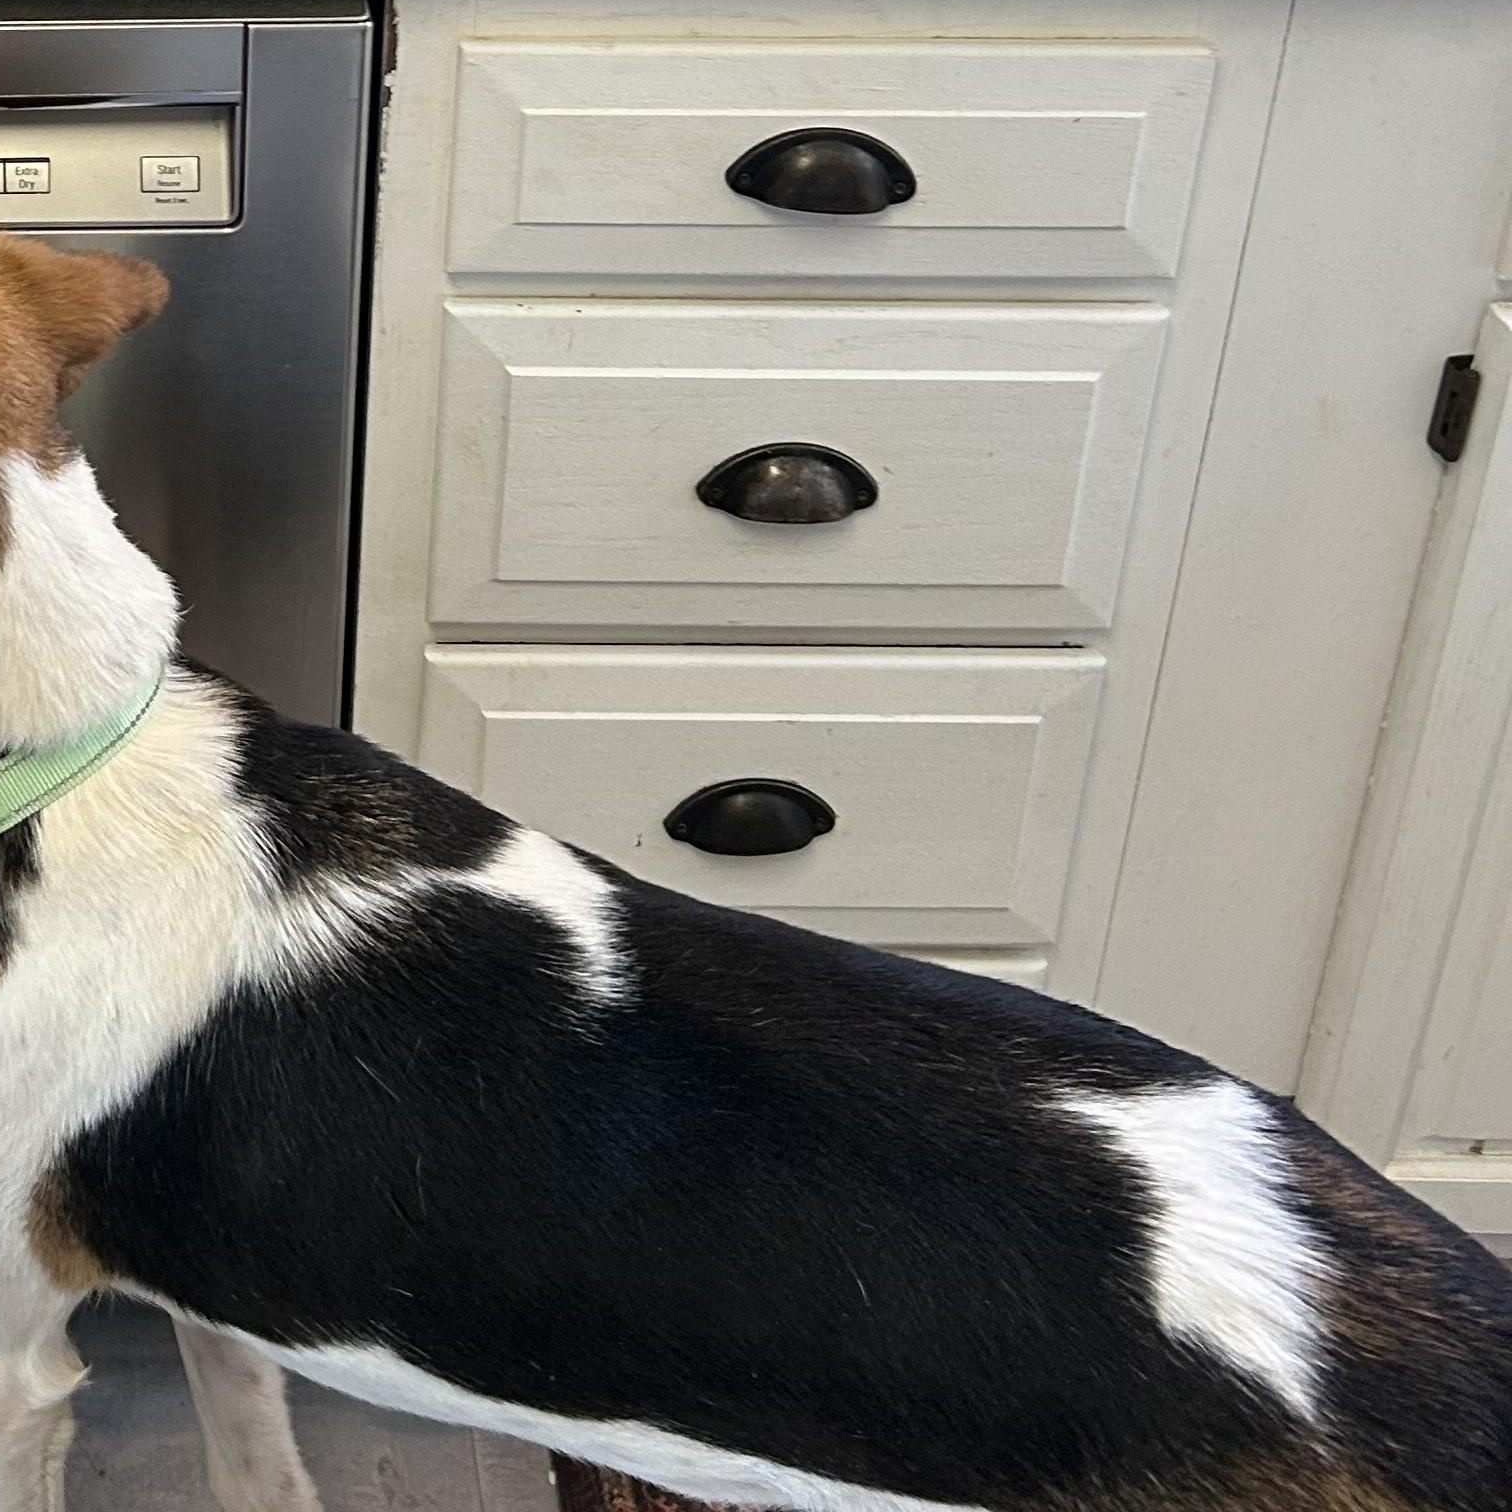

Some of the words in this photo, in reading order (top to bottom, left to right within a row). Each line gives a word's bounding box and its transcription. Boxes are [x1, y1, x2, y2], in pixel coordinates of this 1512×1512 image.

[15, 166, 39, 177] Extra
[156, 164, 183, 175] Start
[18, 178, 37, 191] Dry
